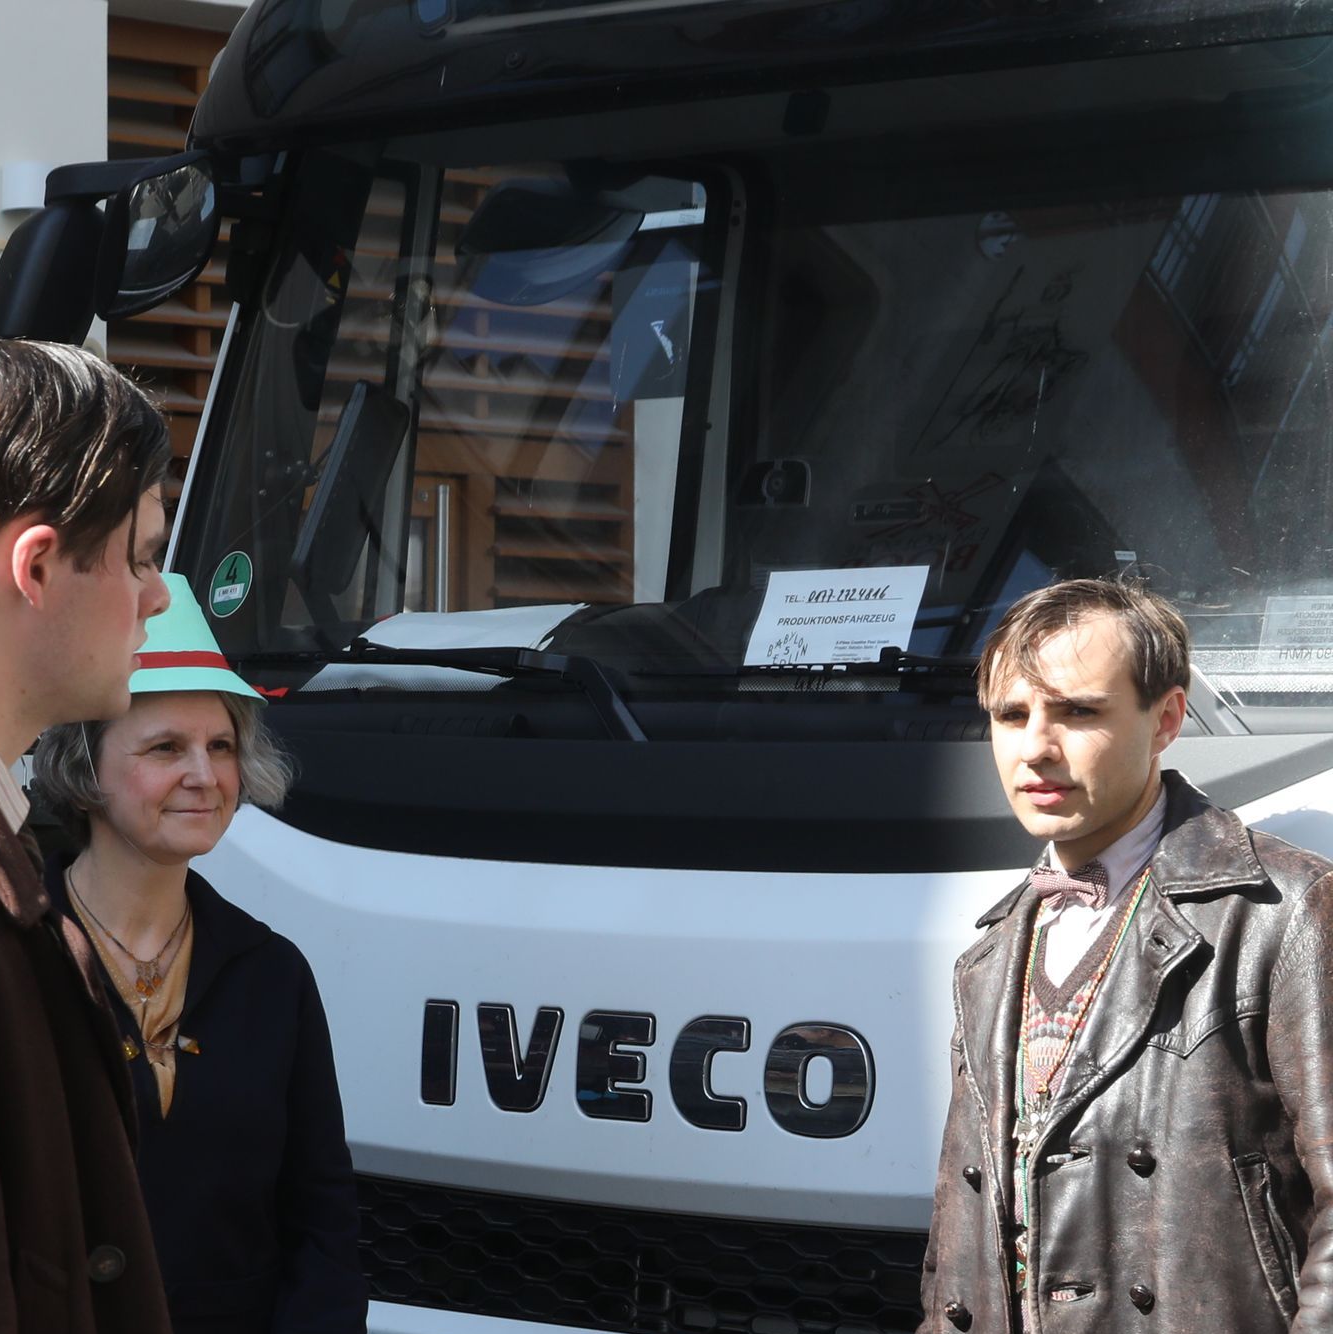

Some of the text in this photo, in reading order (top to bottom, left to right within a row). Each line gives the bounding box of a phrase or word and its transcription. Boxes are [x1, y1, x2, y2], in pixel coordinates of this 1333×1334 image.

[226, 556, 238, 584] 4
[776, 613, 896, 626] PRODUKTIONSFAHRZEUG
[420, 998, 877, 1139] IVECO
